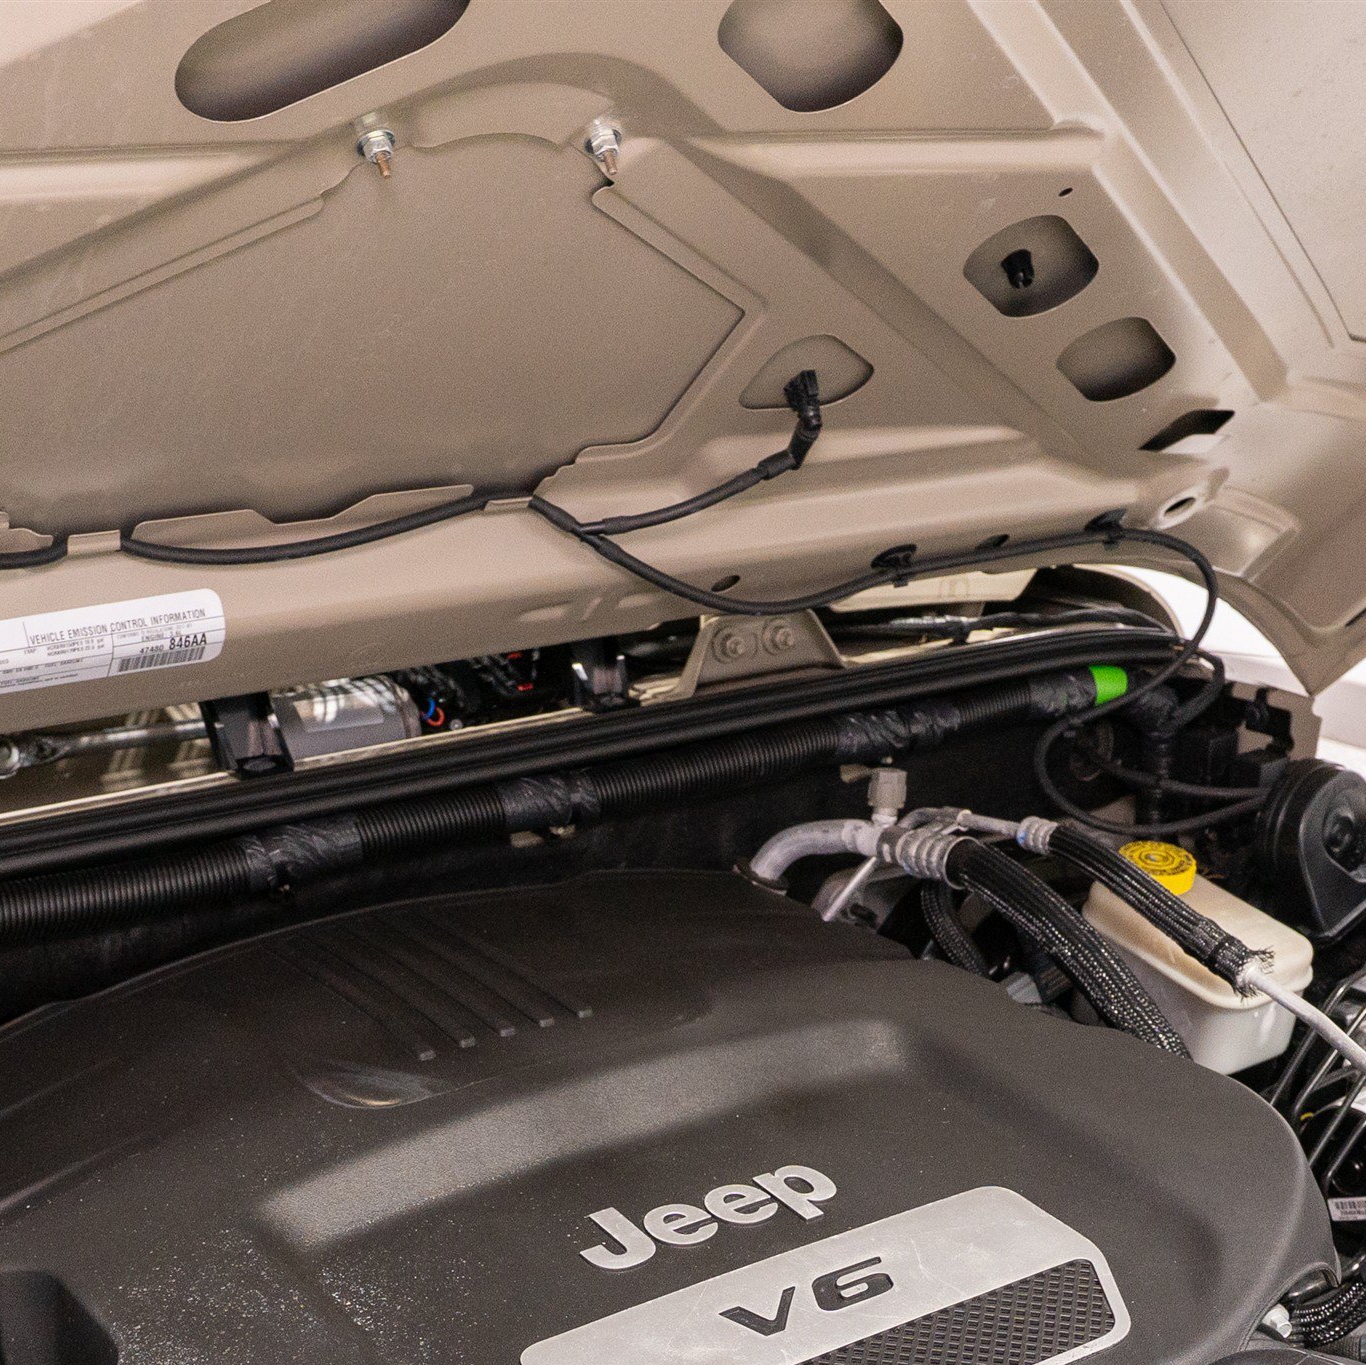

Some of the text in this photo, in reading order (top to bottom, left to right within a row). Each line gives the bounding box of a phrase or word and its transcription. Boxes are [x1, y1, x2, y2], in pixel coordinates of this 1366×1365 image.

[29, 630, 65, 645] VEHICLE
[67, 624, 108, 639] EMISSION
[110, 616, 147, 632] CONTROL
[150, 608, 206, 625] INFORMATION
[168, 631, 207, 651] 846AA
[580, 1163, 838, 1271] Jeep
[718, 1255, 895, 1338] V6
